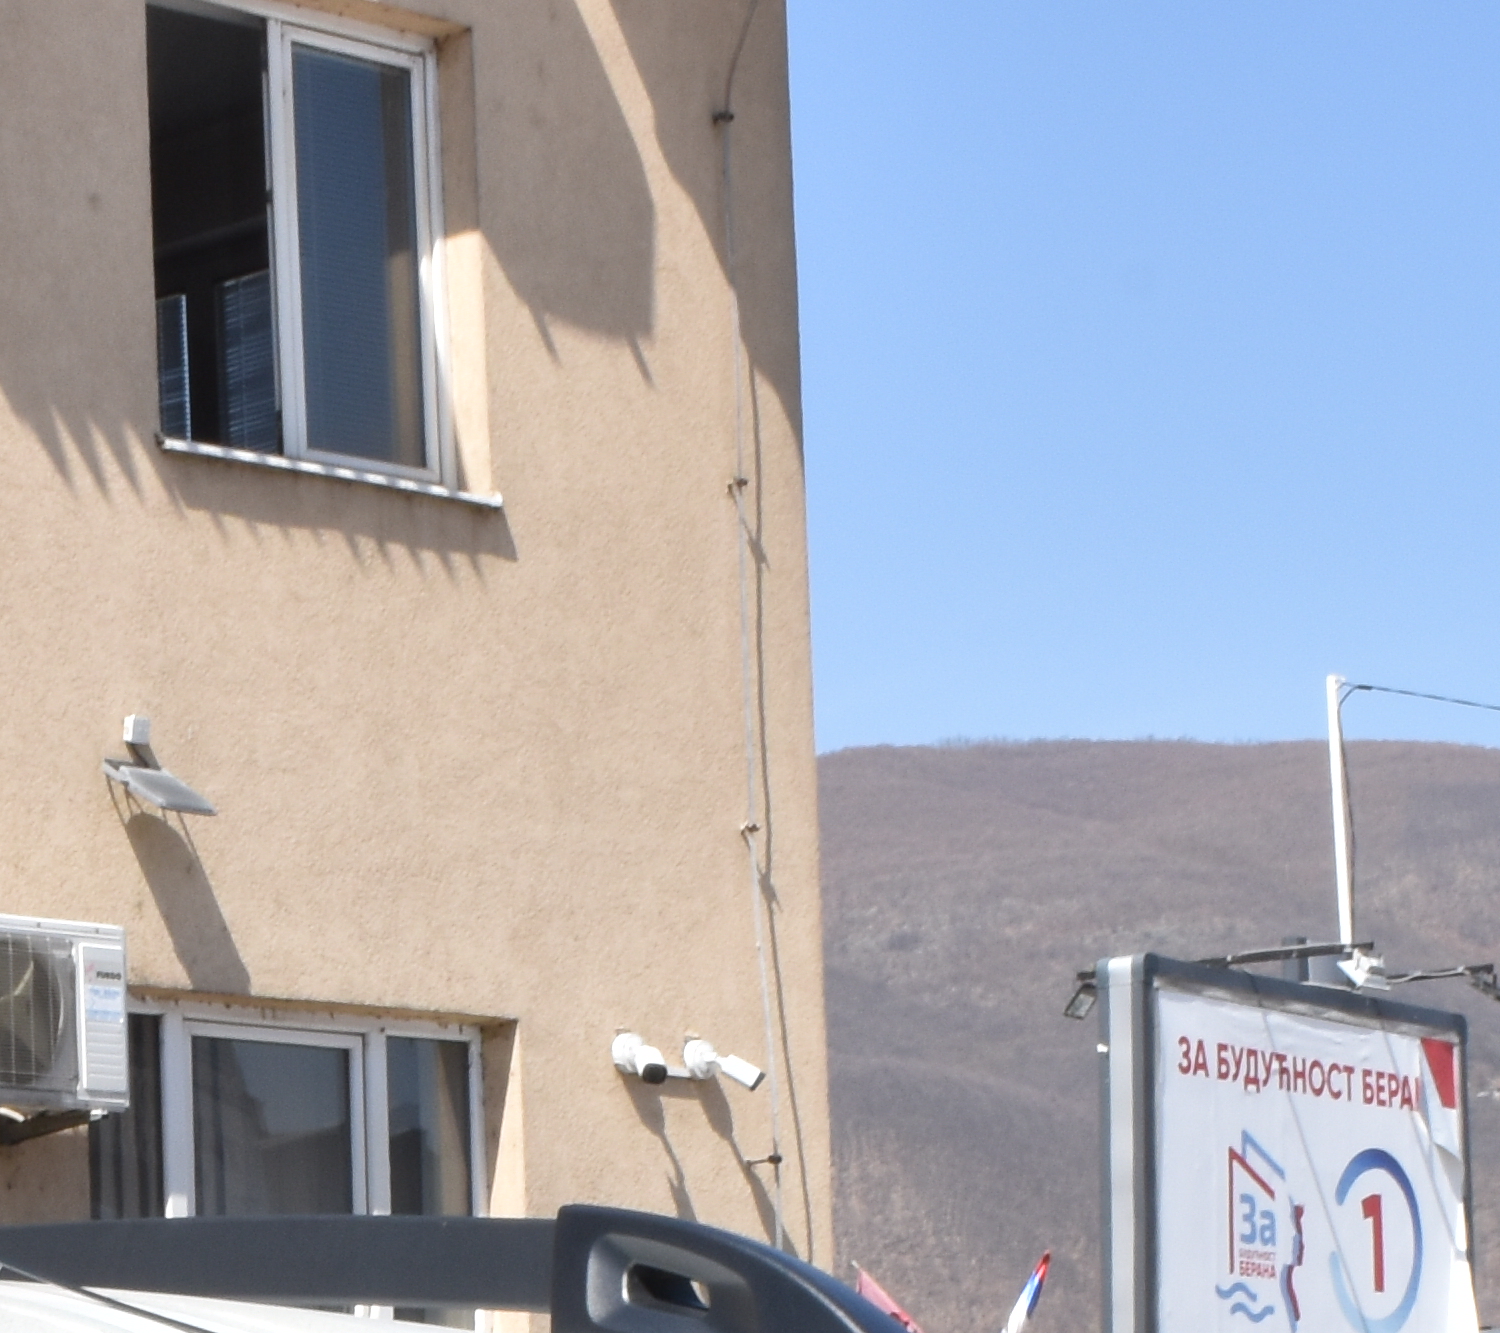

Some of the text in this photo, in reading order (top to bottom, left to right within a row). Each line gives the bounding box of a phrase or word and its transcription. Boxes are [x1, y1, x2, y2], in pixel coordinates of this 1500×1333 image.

[1178, 1036, 1210, 1077] ЗА
[1216, 1043, 1356, 1102] БУДУЋНОСТ
[1239, 1193, 1276, 1247] За
[1362, 1193, 1384, 1293] 1
